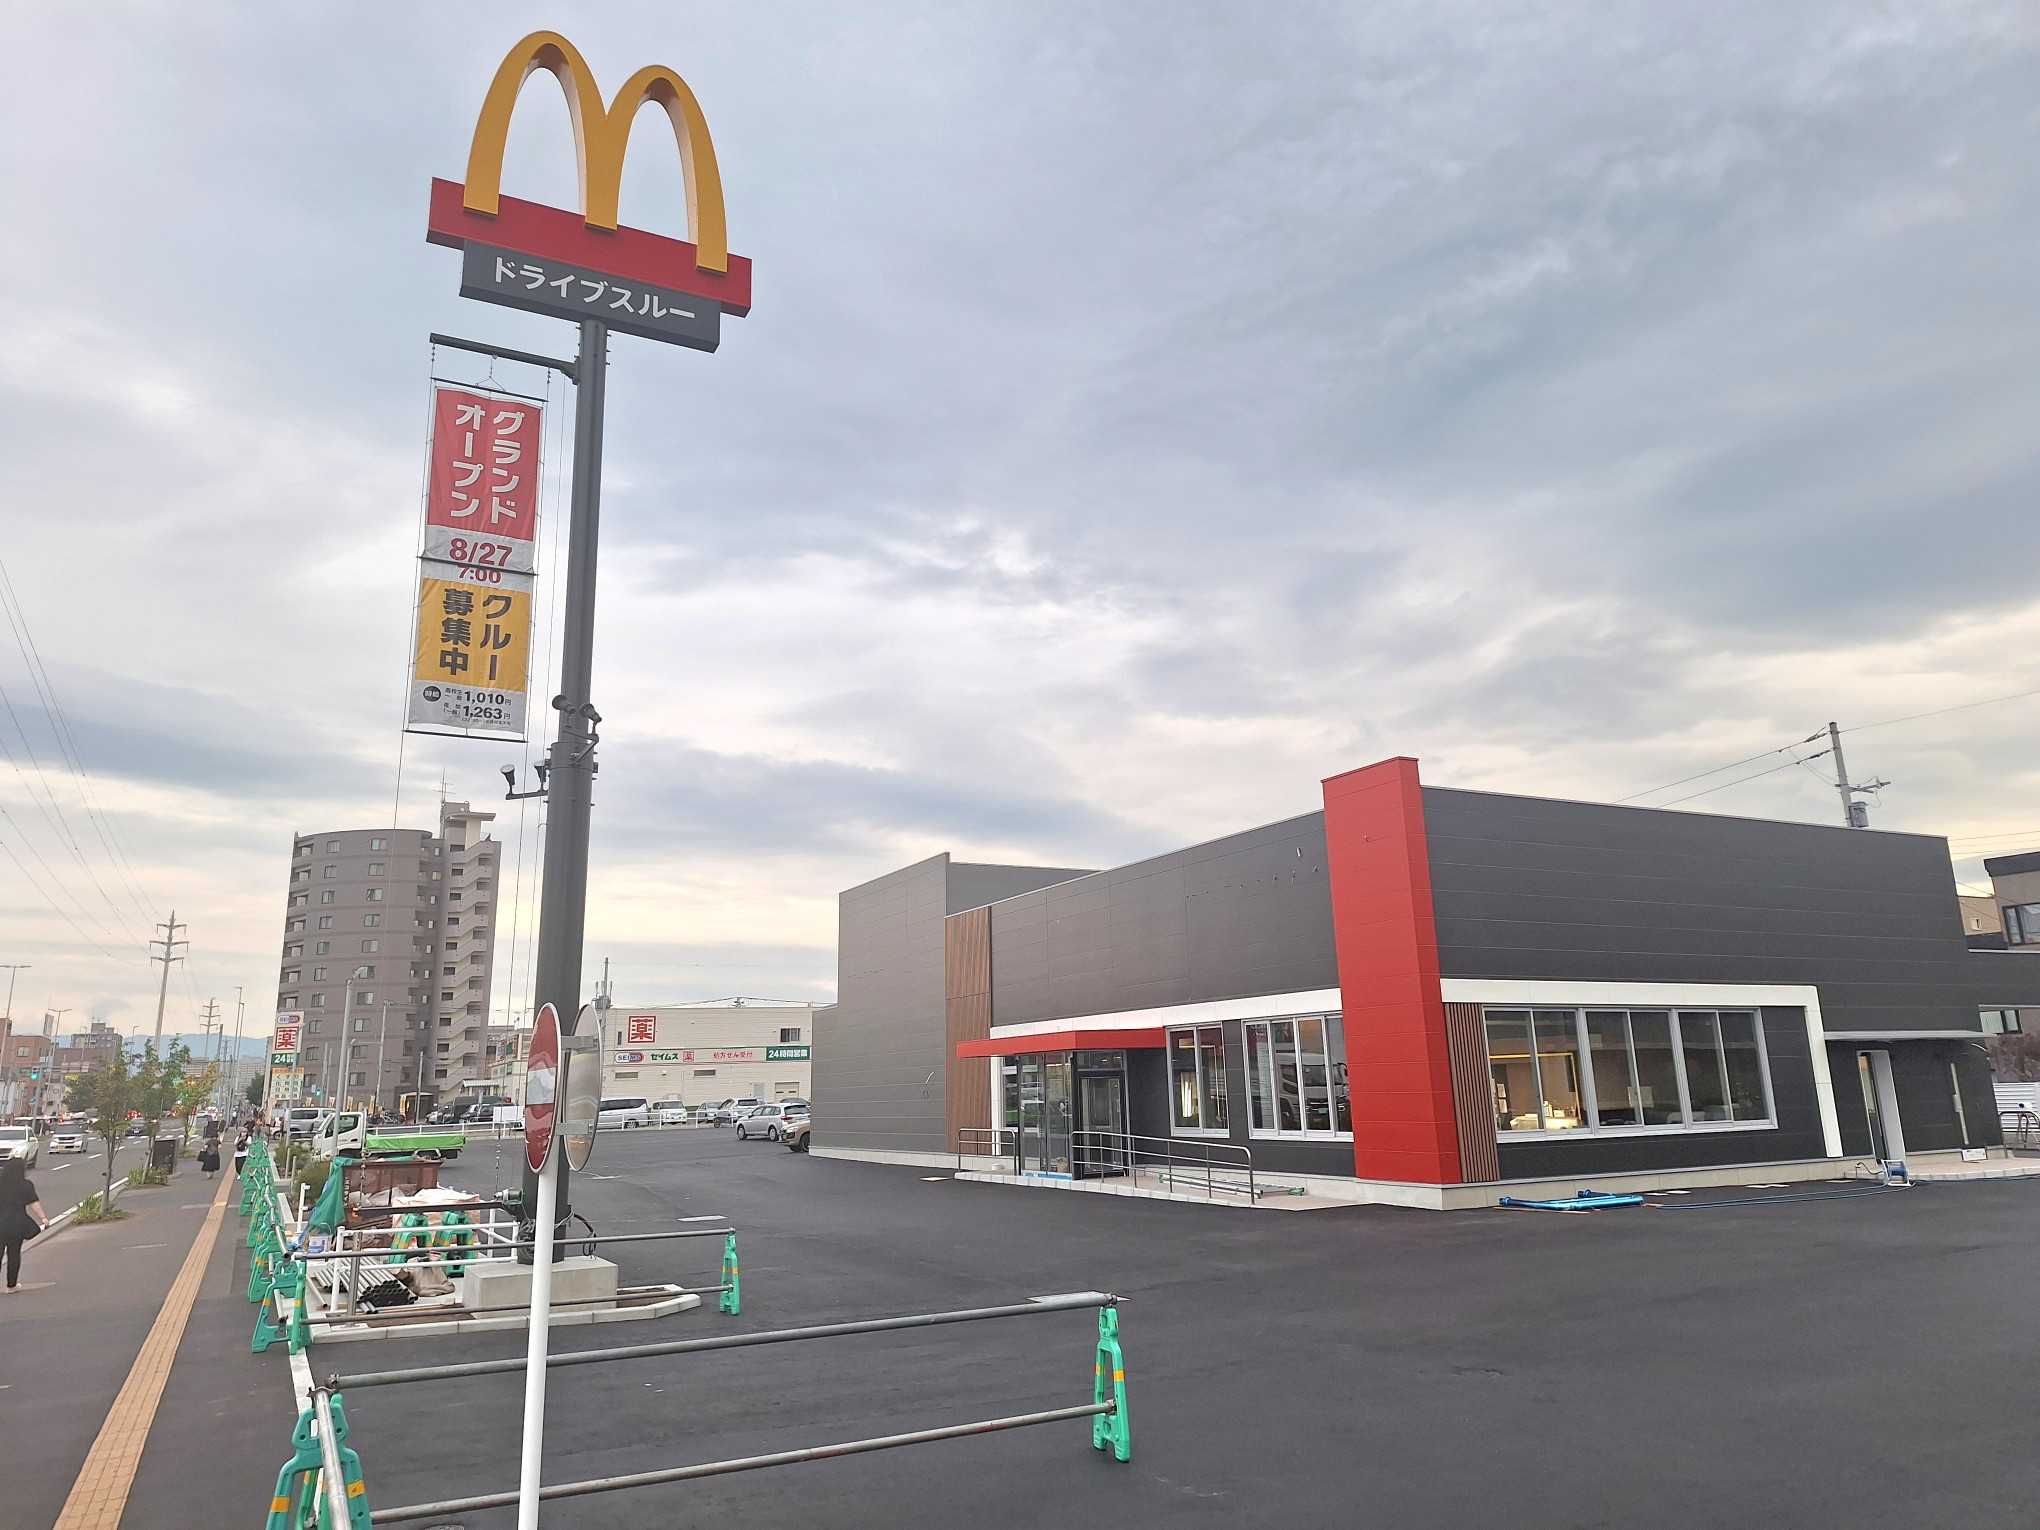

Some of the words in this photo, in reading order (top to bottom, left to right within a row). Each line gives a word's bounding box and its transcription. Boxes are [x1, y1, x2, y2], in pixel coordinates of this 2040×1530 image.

[494, 256, 696, 320] ドライブスルー
[450, 403, 486, 518] オープン
[490, 411, 525, 525] グランド
[449, 537, 513, 567] 8/27
[457, 564, 502, 584] 7:00
[439, 588, 475, 676] 募集中
[479, 594, 512, 681] クルー
[630, 1018, 653, 1040] 薬
[650, 1053, 679, 1061] セイムス
